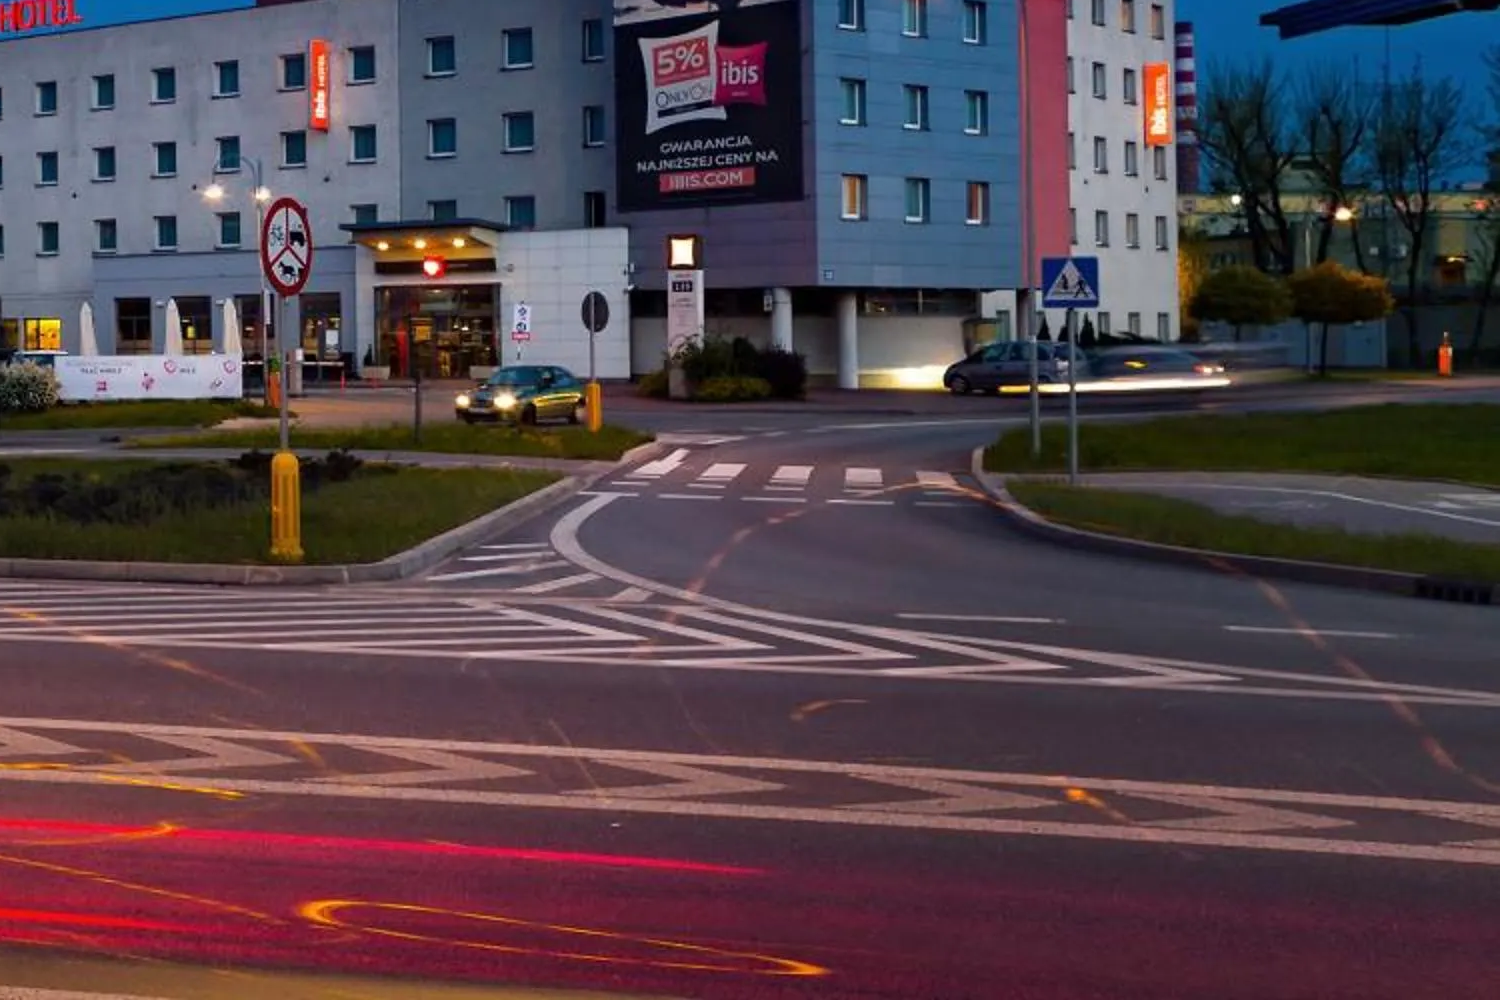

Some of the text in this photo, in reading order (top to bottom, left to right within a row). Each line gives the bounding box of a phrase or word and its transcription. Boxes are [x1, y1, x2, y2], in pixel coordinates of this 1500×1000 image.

[721, 60, 759, 86] ibis
[660, 135, 752, 154] GWARANCJA
[715, 151, 753, 166] CENY
[755, 149, 779, 163] NA
